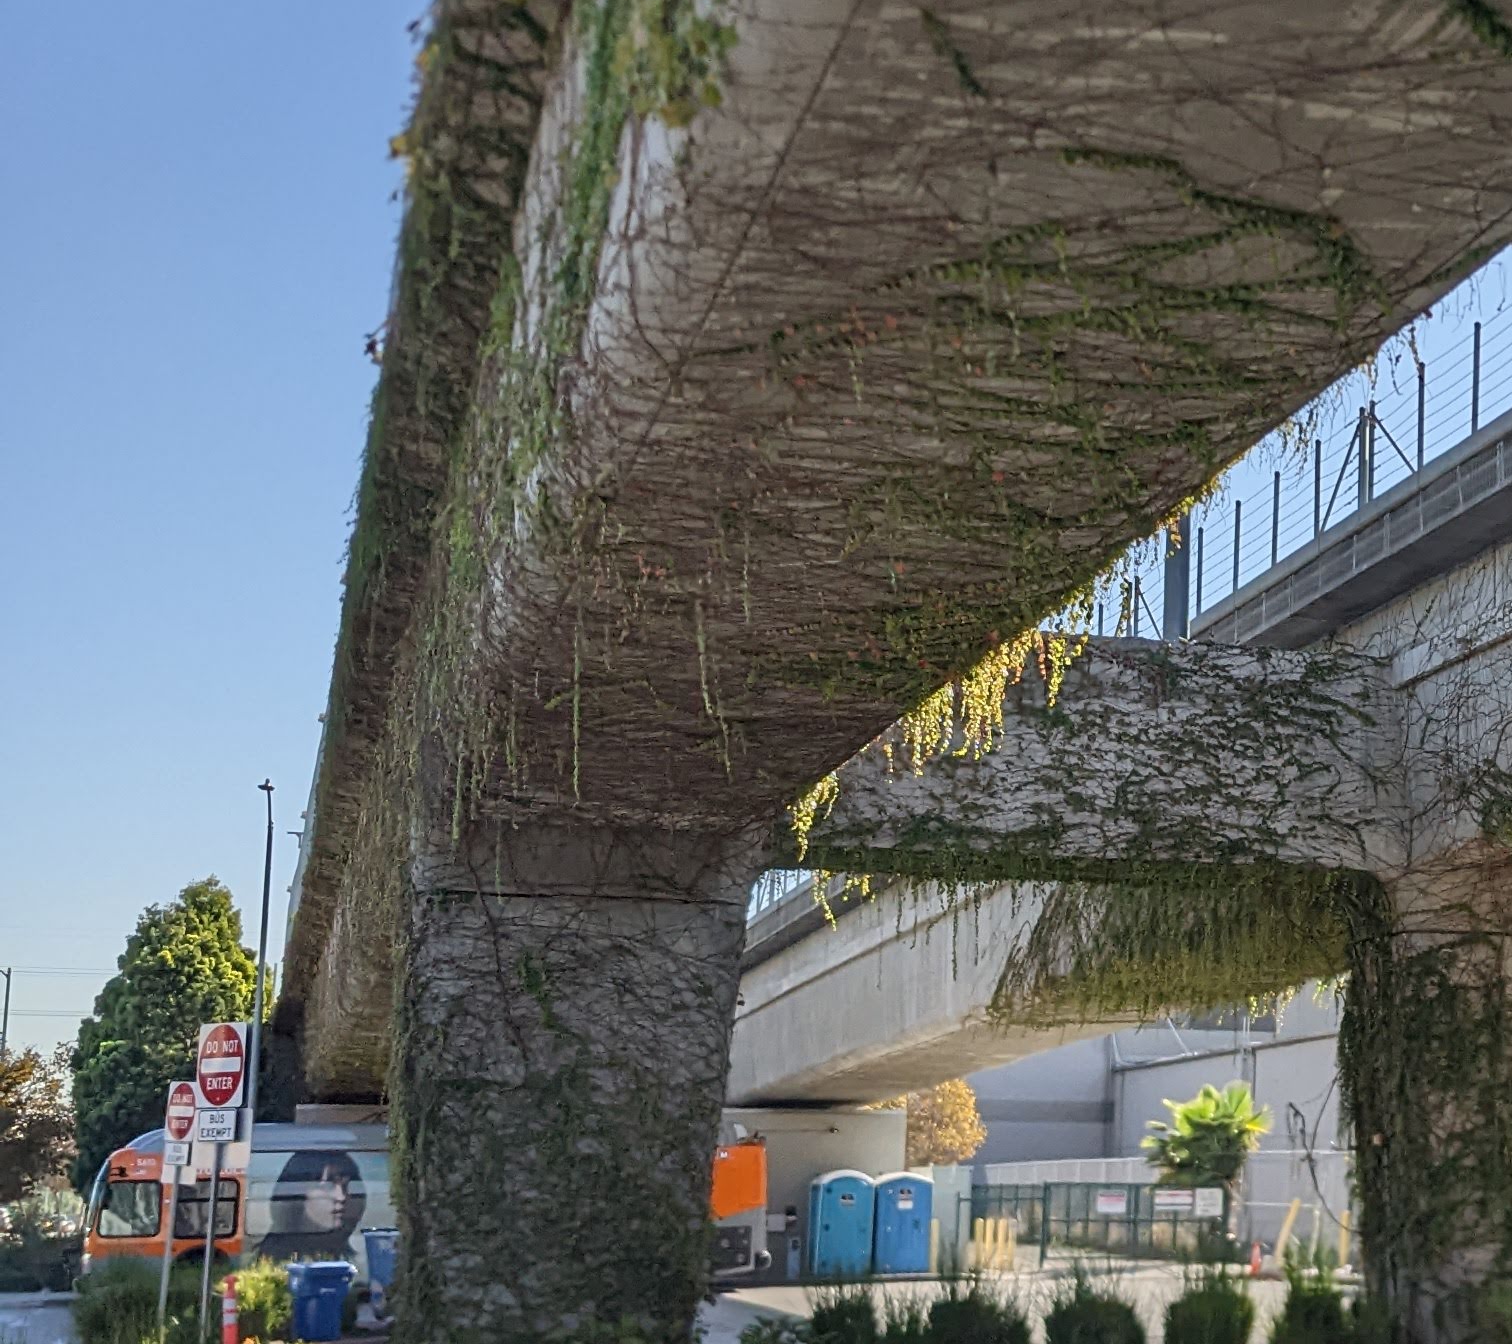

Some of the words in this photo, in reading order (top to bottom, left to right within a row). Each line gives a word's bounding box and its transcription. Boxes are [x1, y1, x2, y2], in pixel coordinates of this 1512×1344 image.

[206, 1040, 218, 1054] DO
[222, 1039, 239, 1053] NOT
[206, 1076, 233, 1090] ENTER
[209, 1113, 225, 1124] BUS
[200, 1127, 232, 1138] EXEMPT
